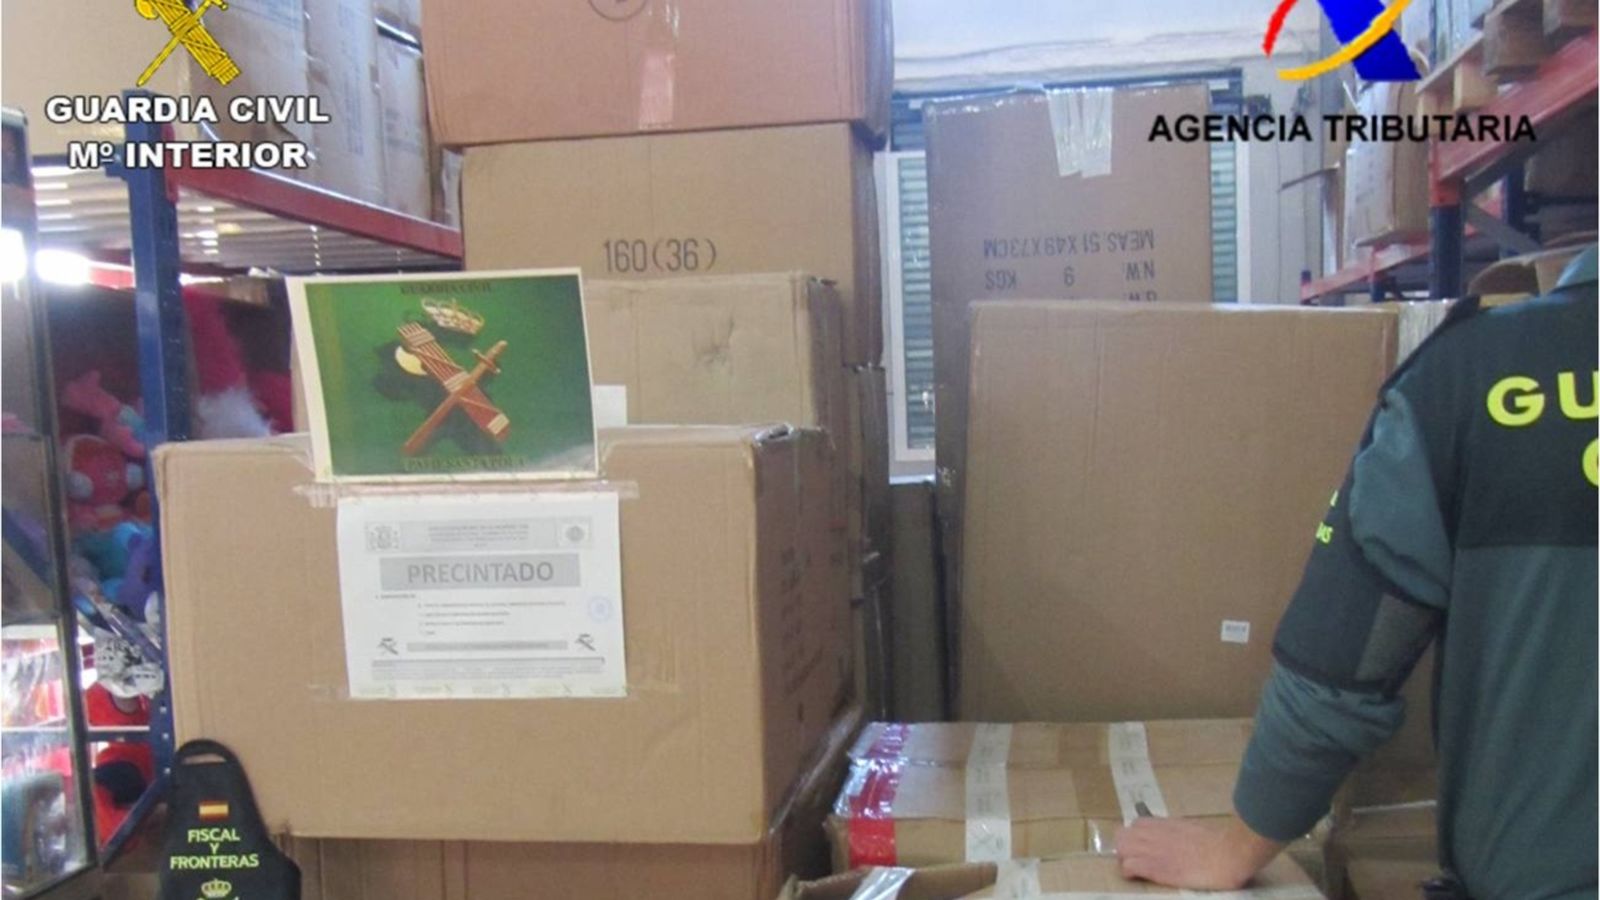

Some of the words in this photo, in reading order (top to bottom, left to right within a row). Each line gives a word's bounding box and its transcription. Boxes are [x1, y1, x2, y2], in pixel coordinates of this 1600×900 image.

[984, 269, 1017, 290] KGS
[407, 560, 554, 584] PRECINTADO
[187, 828, 241, 843] FISCAL
[209, 842, 220, 855] Y
[170, 853, 260, 870] FRONTERAS
